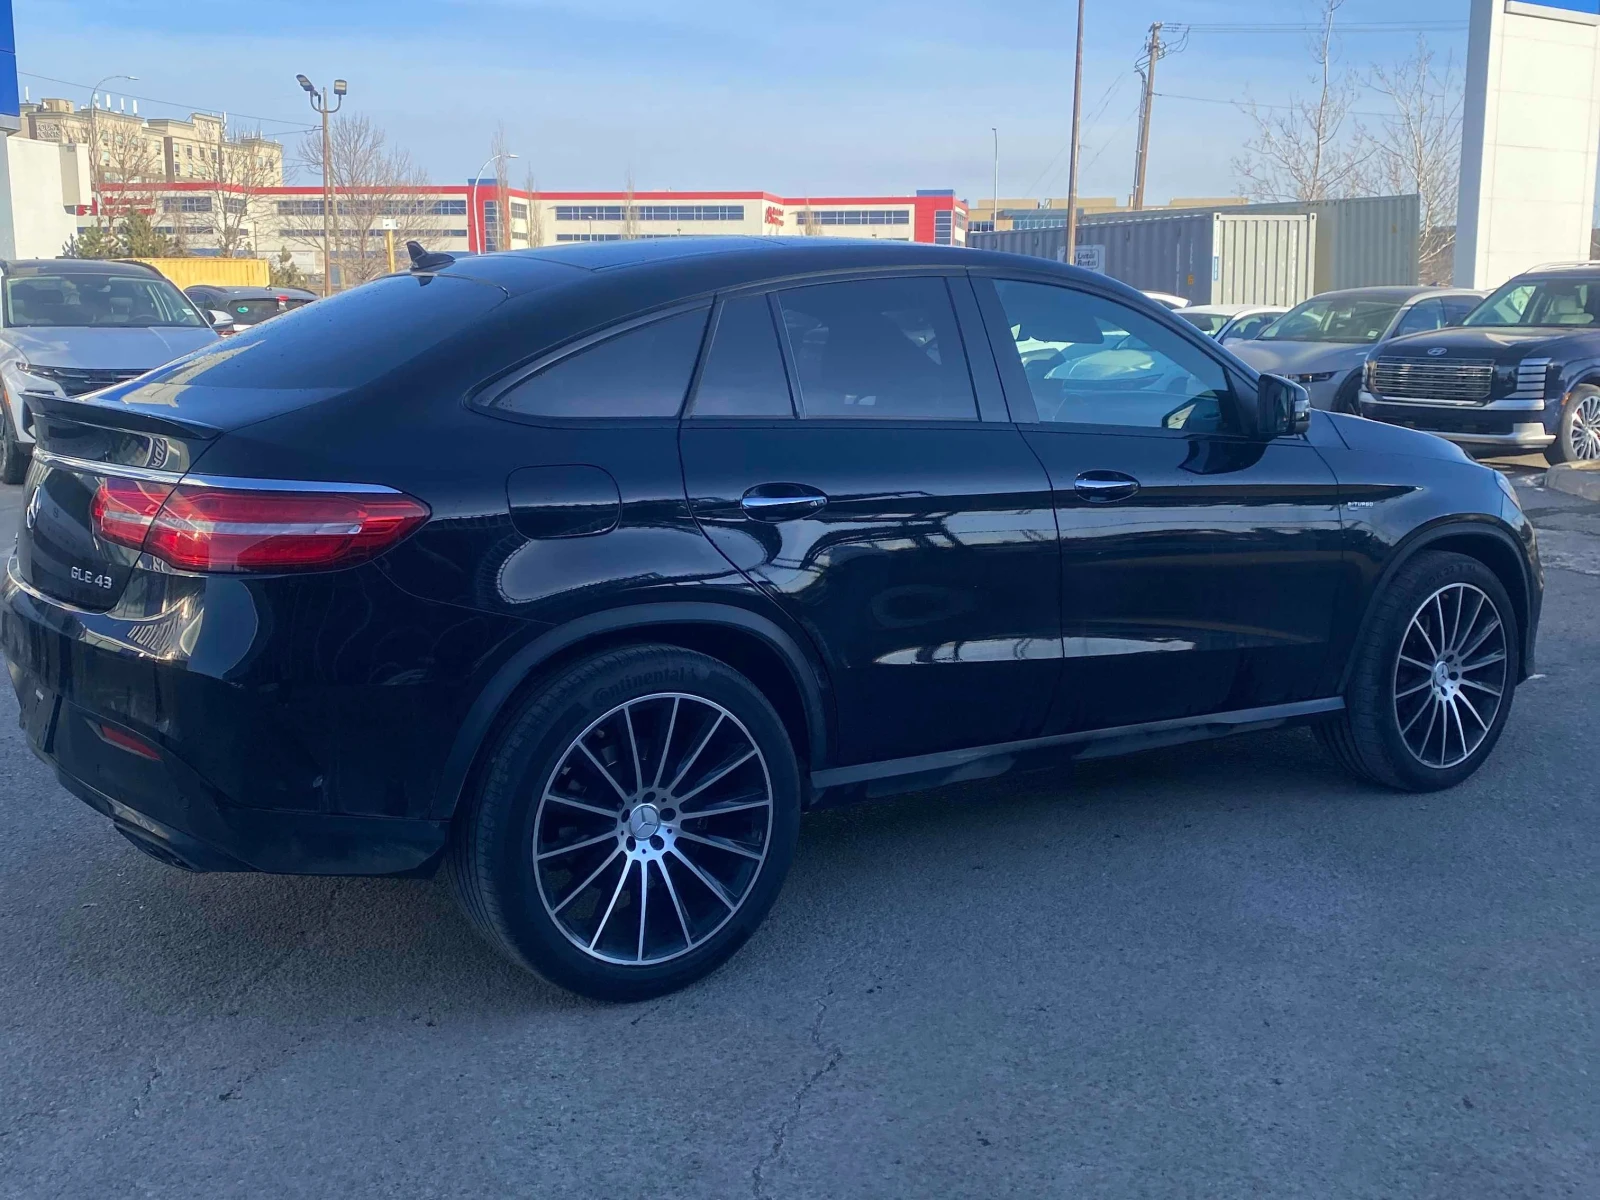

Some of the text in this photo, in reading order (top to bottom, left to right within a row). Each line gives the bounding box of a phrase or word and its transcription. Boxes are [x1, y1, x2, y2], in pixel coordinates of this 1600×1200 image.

[71, 566, 112, 589] GLE 43
[593, 667, 684, 703] Continental
